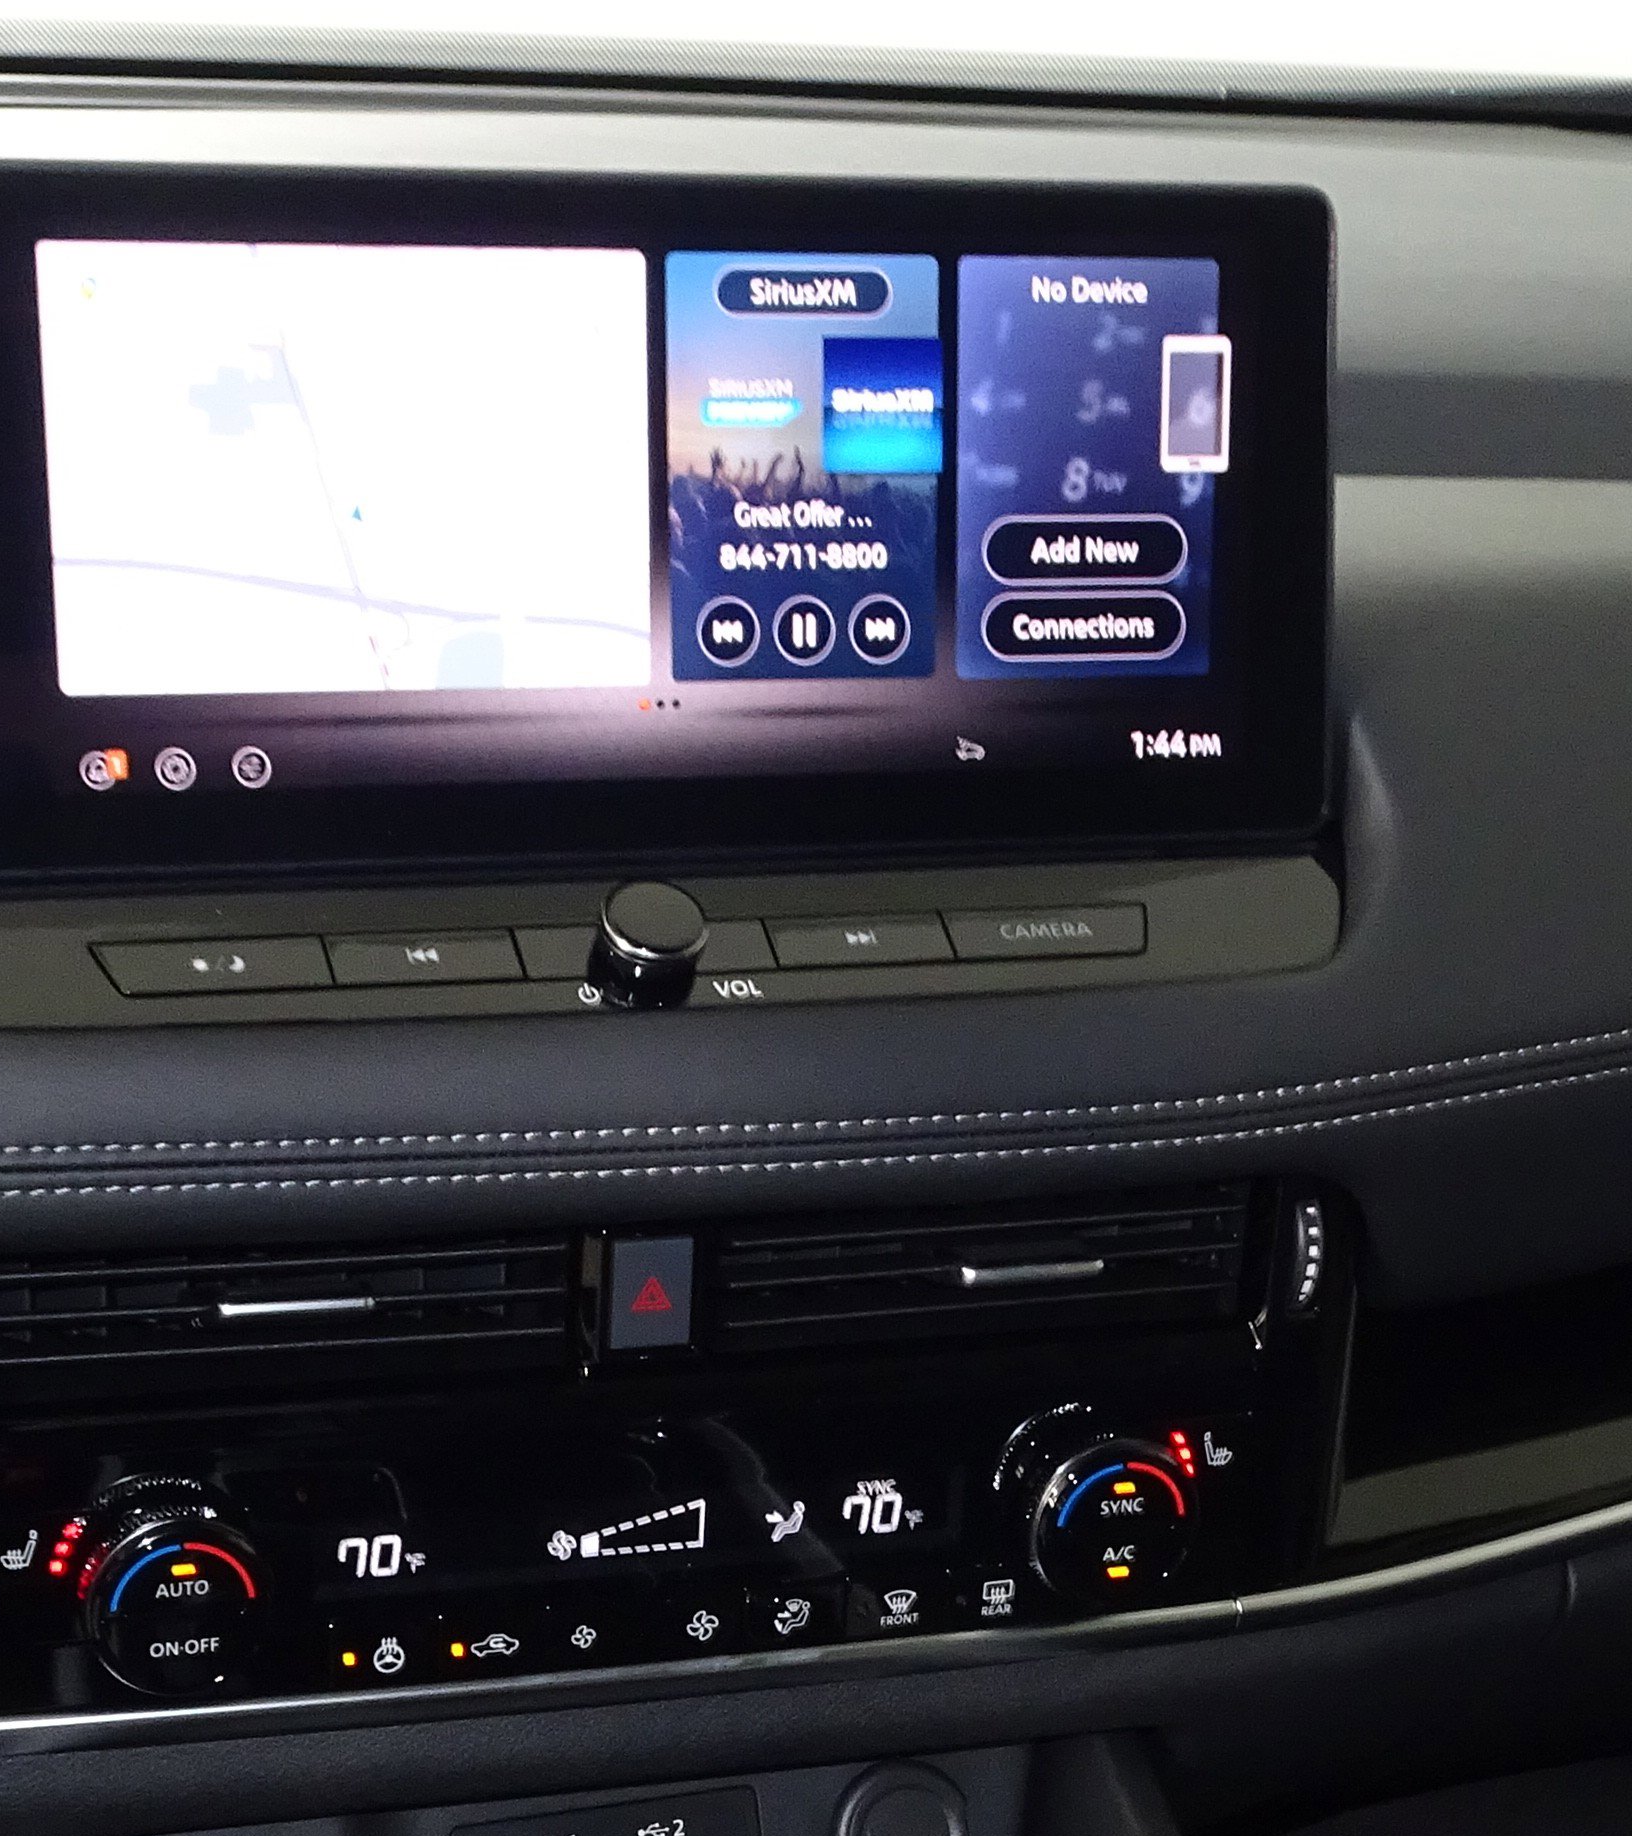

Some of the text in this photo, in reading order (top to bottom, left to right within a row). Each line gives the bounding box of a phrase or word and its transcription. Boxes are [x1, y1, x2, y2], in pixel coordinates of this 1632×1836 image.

[749, 278, 857, 308] SiriusXM
[1032, 278, 1148, 304] No Device
[734, 502, 794, 529] Great
[797, 501, 844, 529] Offer
[720, 543, 888, 571] 844-711-8800
[1030, 536, 1139, 564] Add New
[1012, 614, 1155, 641] Connections
[999, 919, 1093, 944] CAMERA
[712, 977, 764, 1000] VOL
[856, 1479, 898, 1496] SYNC
[1099, 1497, 1145, 1516] SYNC
[1102, 1545, 1135, 1562] A/C
[154, 1578, 210, 1600] AUTO
[879, 1611, 920, 1628] FRONT
[980, 1602, 1012, 1617] REAR
